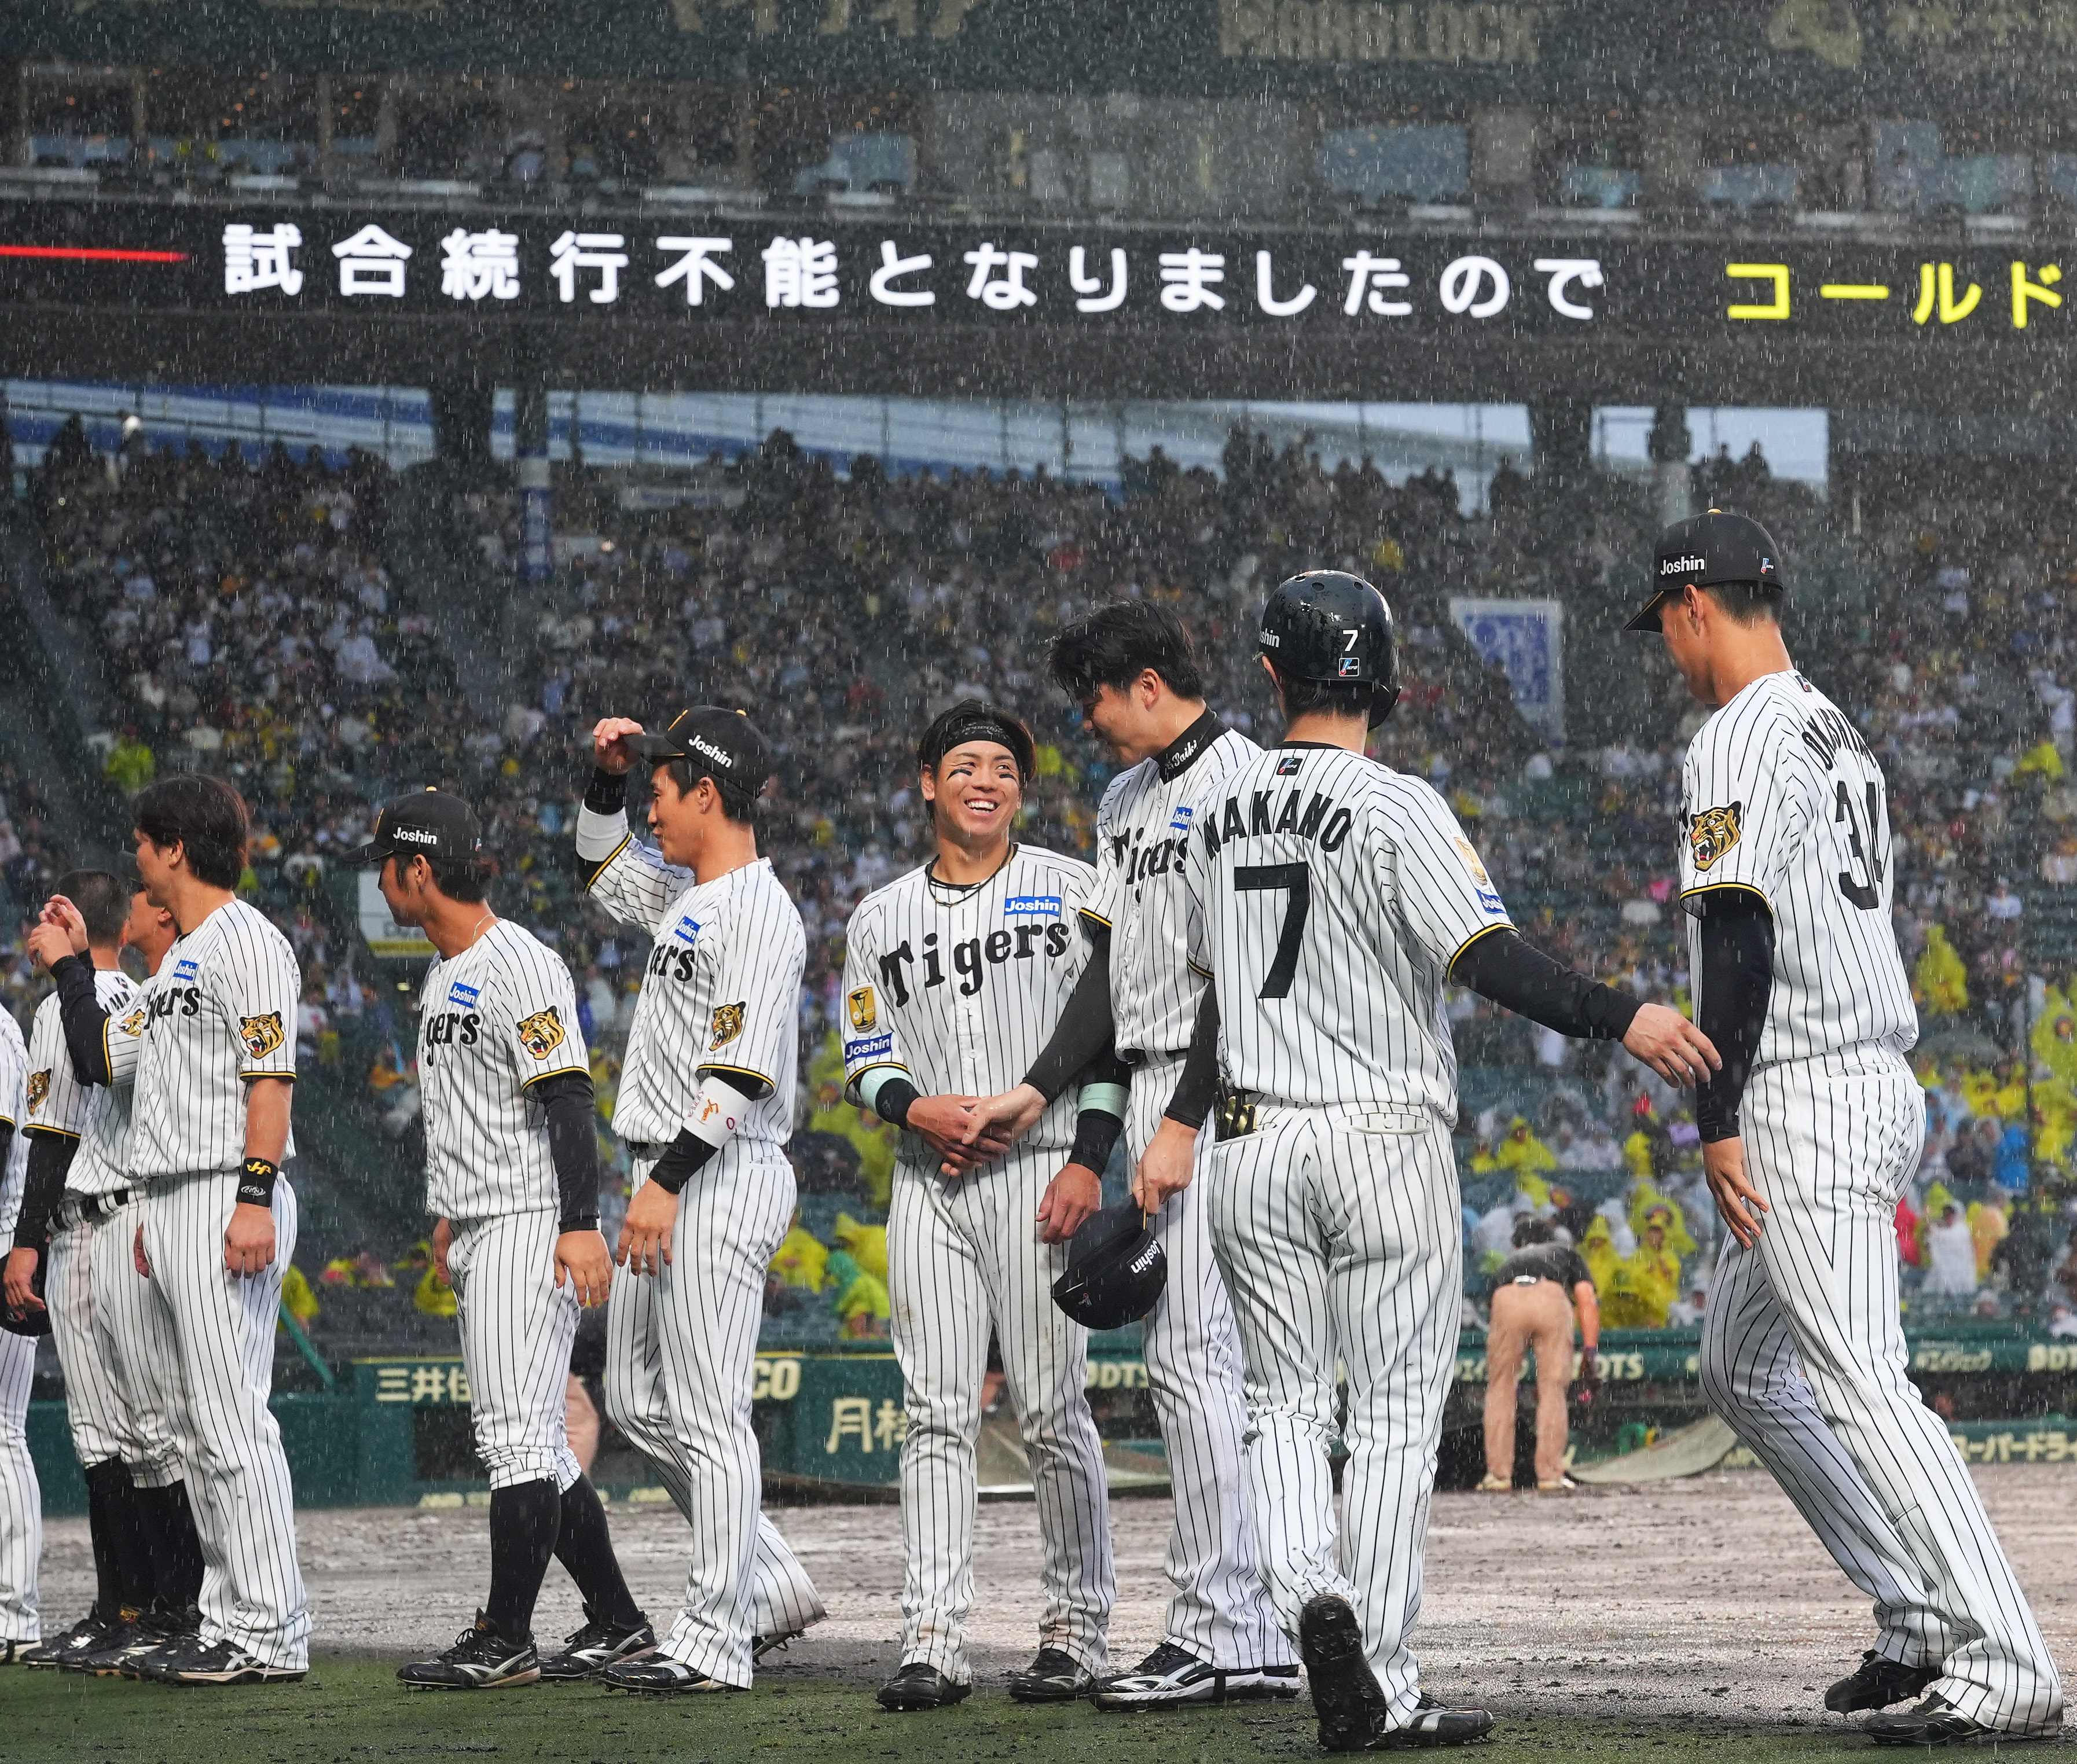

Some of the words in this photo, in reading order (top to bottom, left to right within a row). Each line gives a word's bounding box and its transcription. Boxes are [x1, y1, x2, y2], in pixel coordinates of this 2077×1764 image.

[221, 223, 1605, 321] 試合続行不能となりましたので
[1725, 260, 2063, 330] コールド
[1660, 555, 1705, 576] Joshin
[1259, 627, 1280, 648] shin
[1342, 629, 1359, 652] 7
[688, 734, 735, 769] Joshin
[1172, 739, 1198, 767] Saiki
[392, 826, 438, 846] Joshin
[1203, 789, 1352, 860] NAKANO
[1005, 898, 1060, 913] Joshin
[676, 919, 697, 940] Joshin
[1234, 862, 1309, 999] 7
[879, 923, 1070, 1008] Tigers
[449, 986, 476, 1004] Joshin
[425, 1013, 480, 1067] gers
[846, 1038, 890, 1059] Joshin
[1130, 1239, 1161, 1274] Joshin
